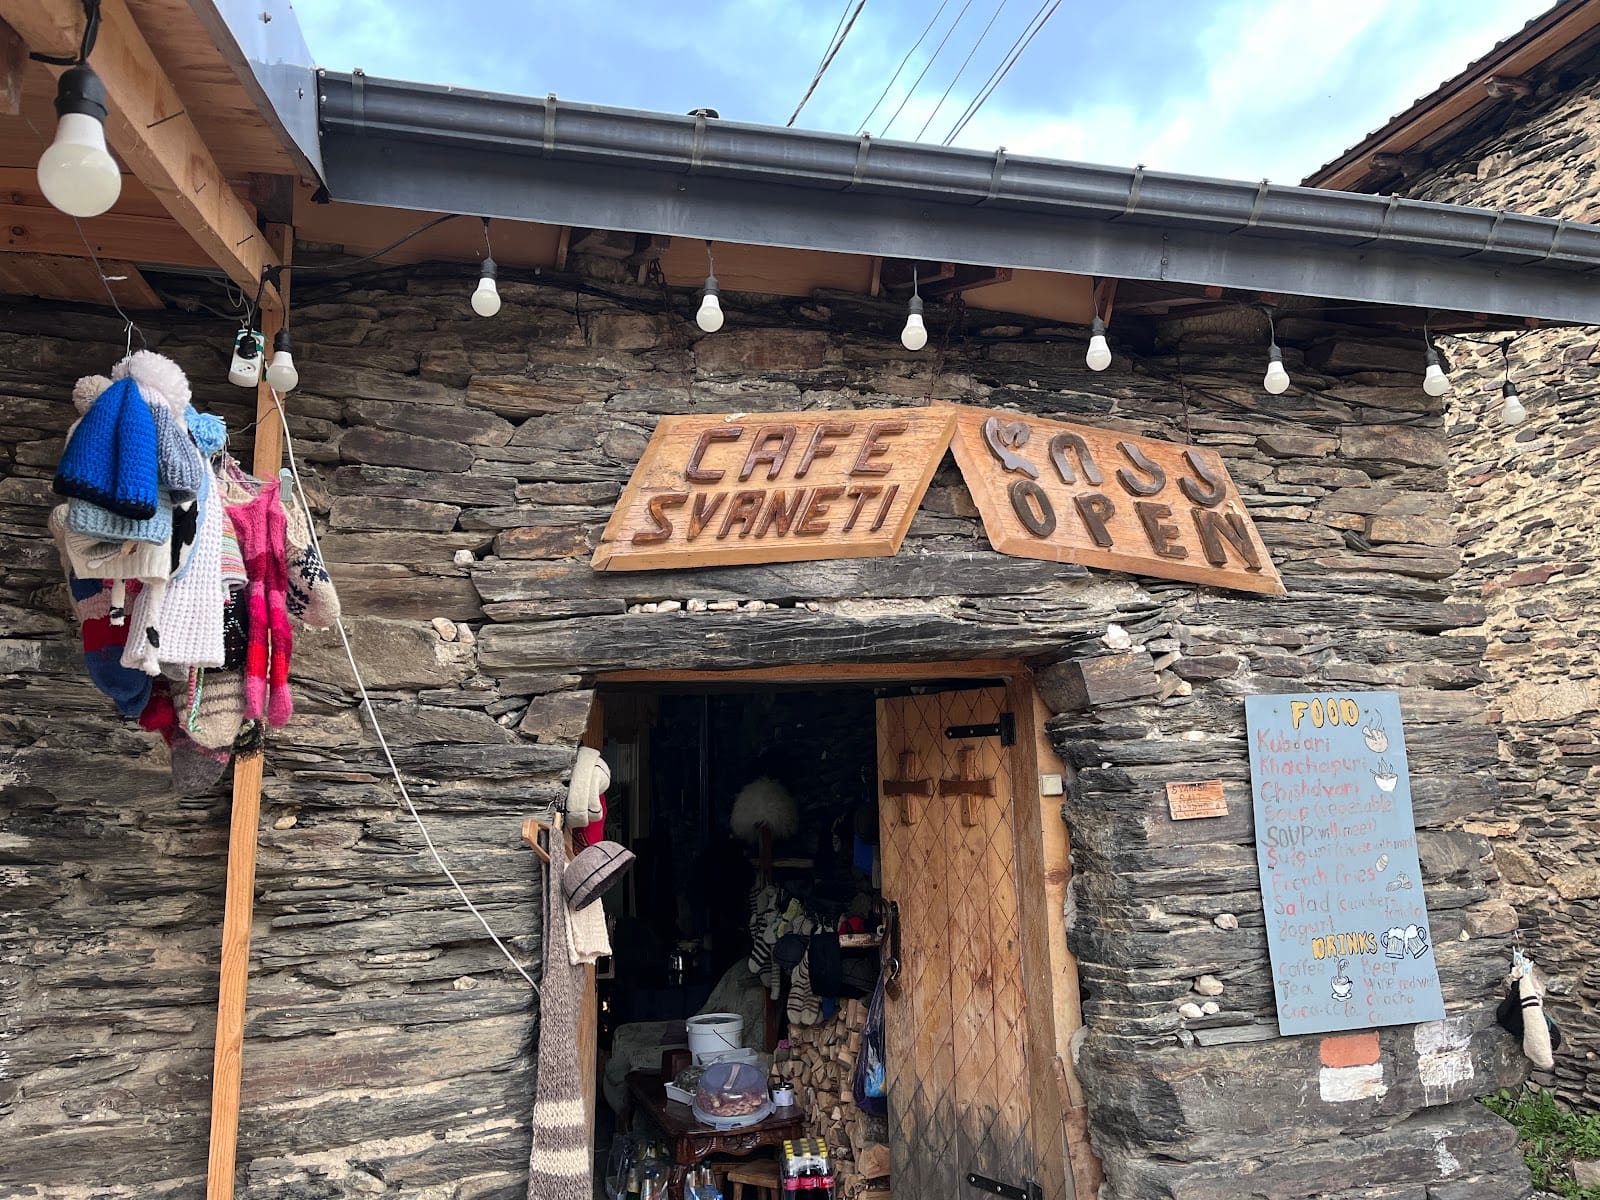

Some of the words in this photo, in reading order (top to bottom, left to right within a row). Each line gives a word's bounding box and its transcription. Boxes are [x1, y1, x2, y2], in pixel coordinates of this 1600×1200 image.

[685, 422, 909, 484] CAFE
[632, 484, 900, 545] SVANETI
[1008, 479, 1262, 572] OPEN
[1290, 698, 1359, 729] FOOD
[1260, 825, 1314, 848] SOUP
[1273, 890, 1330, 916] Salad
[1312, 932, 1378, 960] DRINKS
[1278, 980, 1314, 1000] Tea
